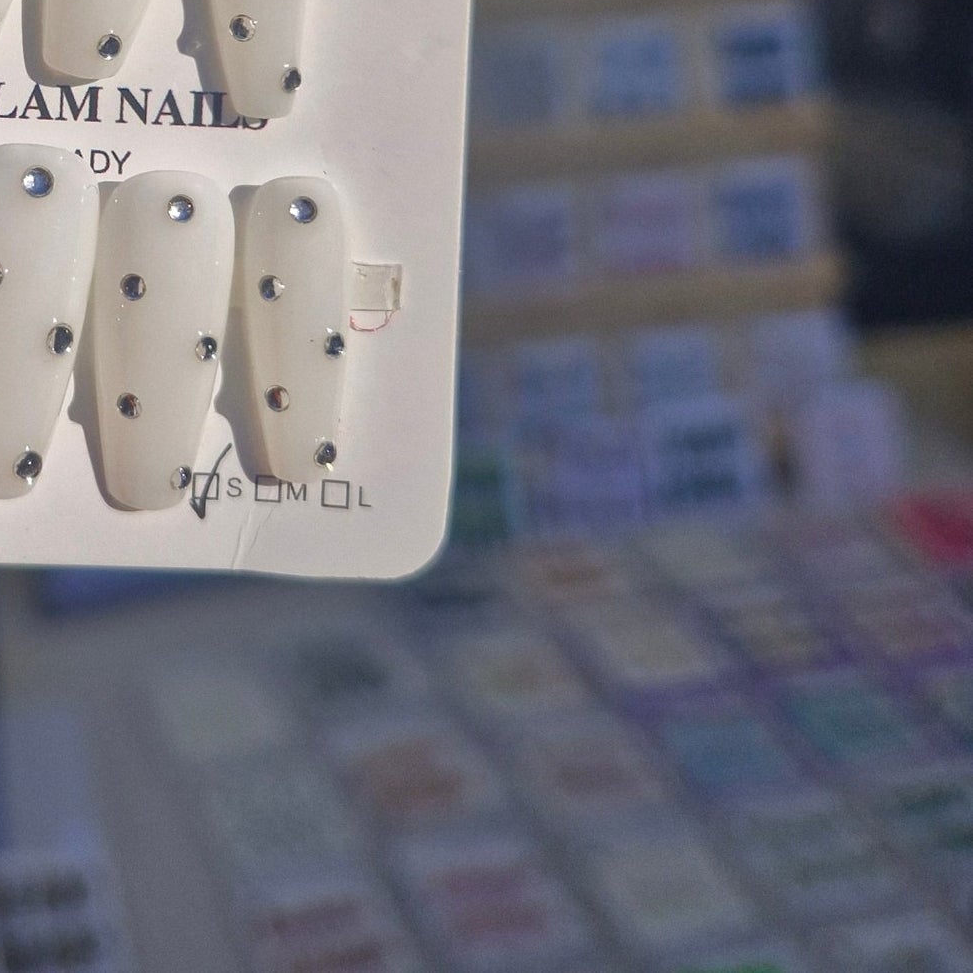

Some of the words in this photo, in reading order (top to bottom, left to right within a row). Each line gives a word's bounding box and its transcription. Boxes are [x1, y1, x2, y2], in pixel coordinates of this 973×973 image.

[226, 477, 243, 498] S
[286, 481, 307, 501] M
[358, 485, 372, 507] L
